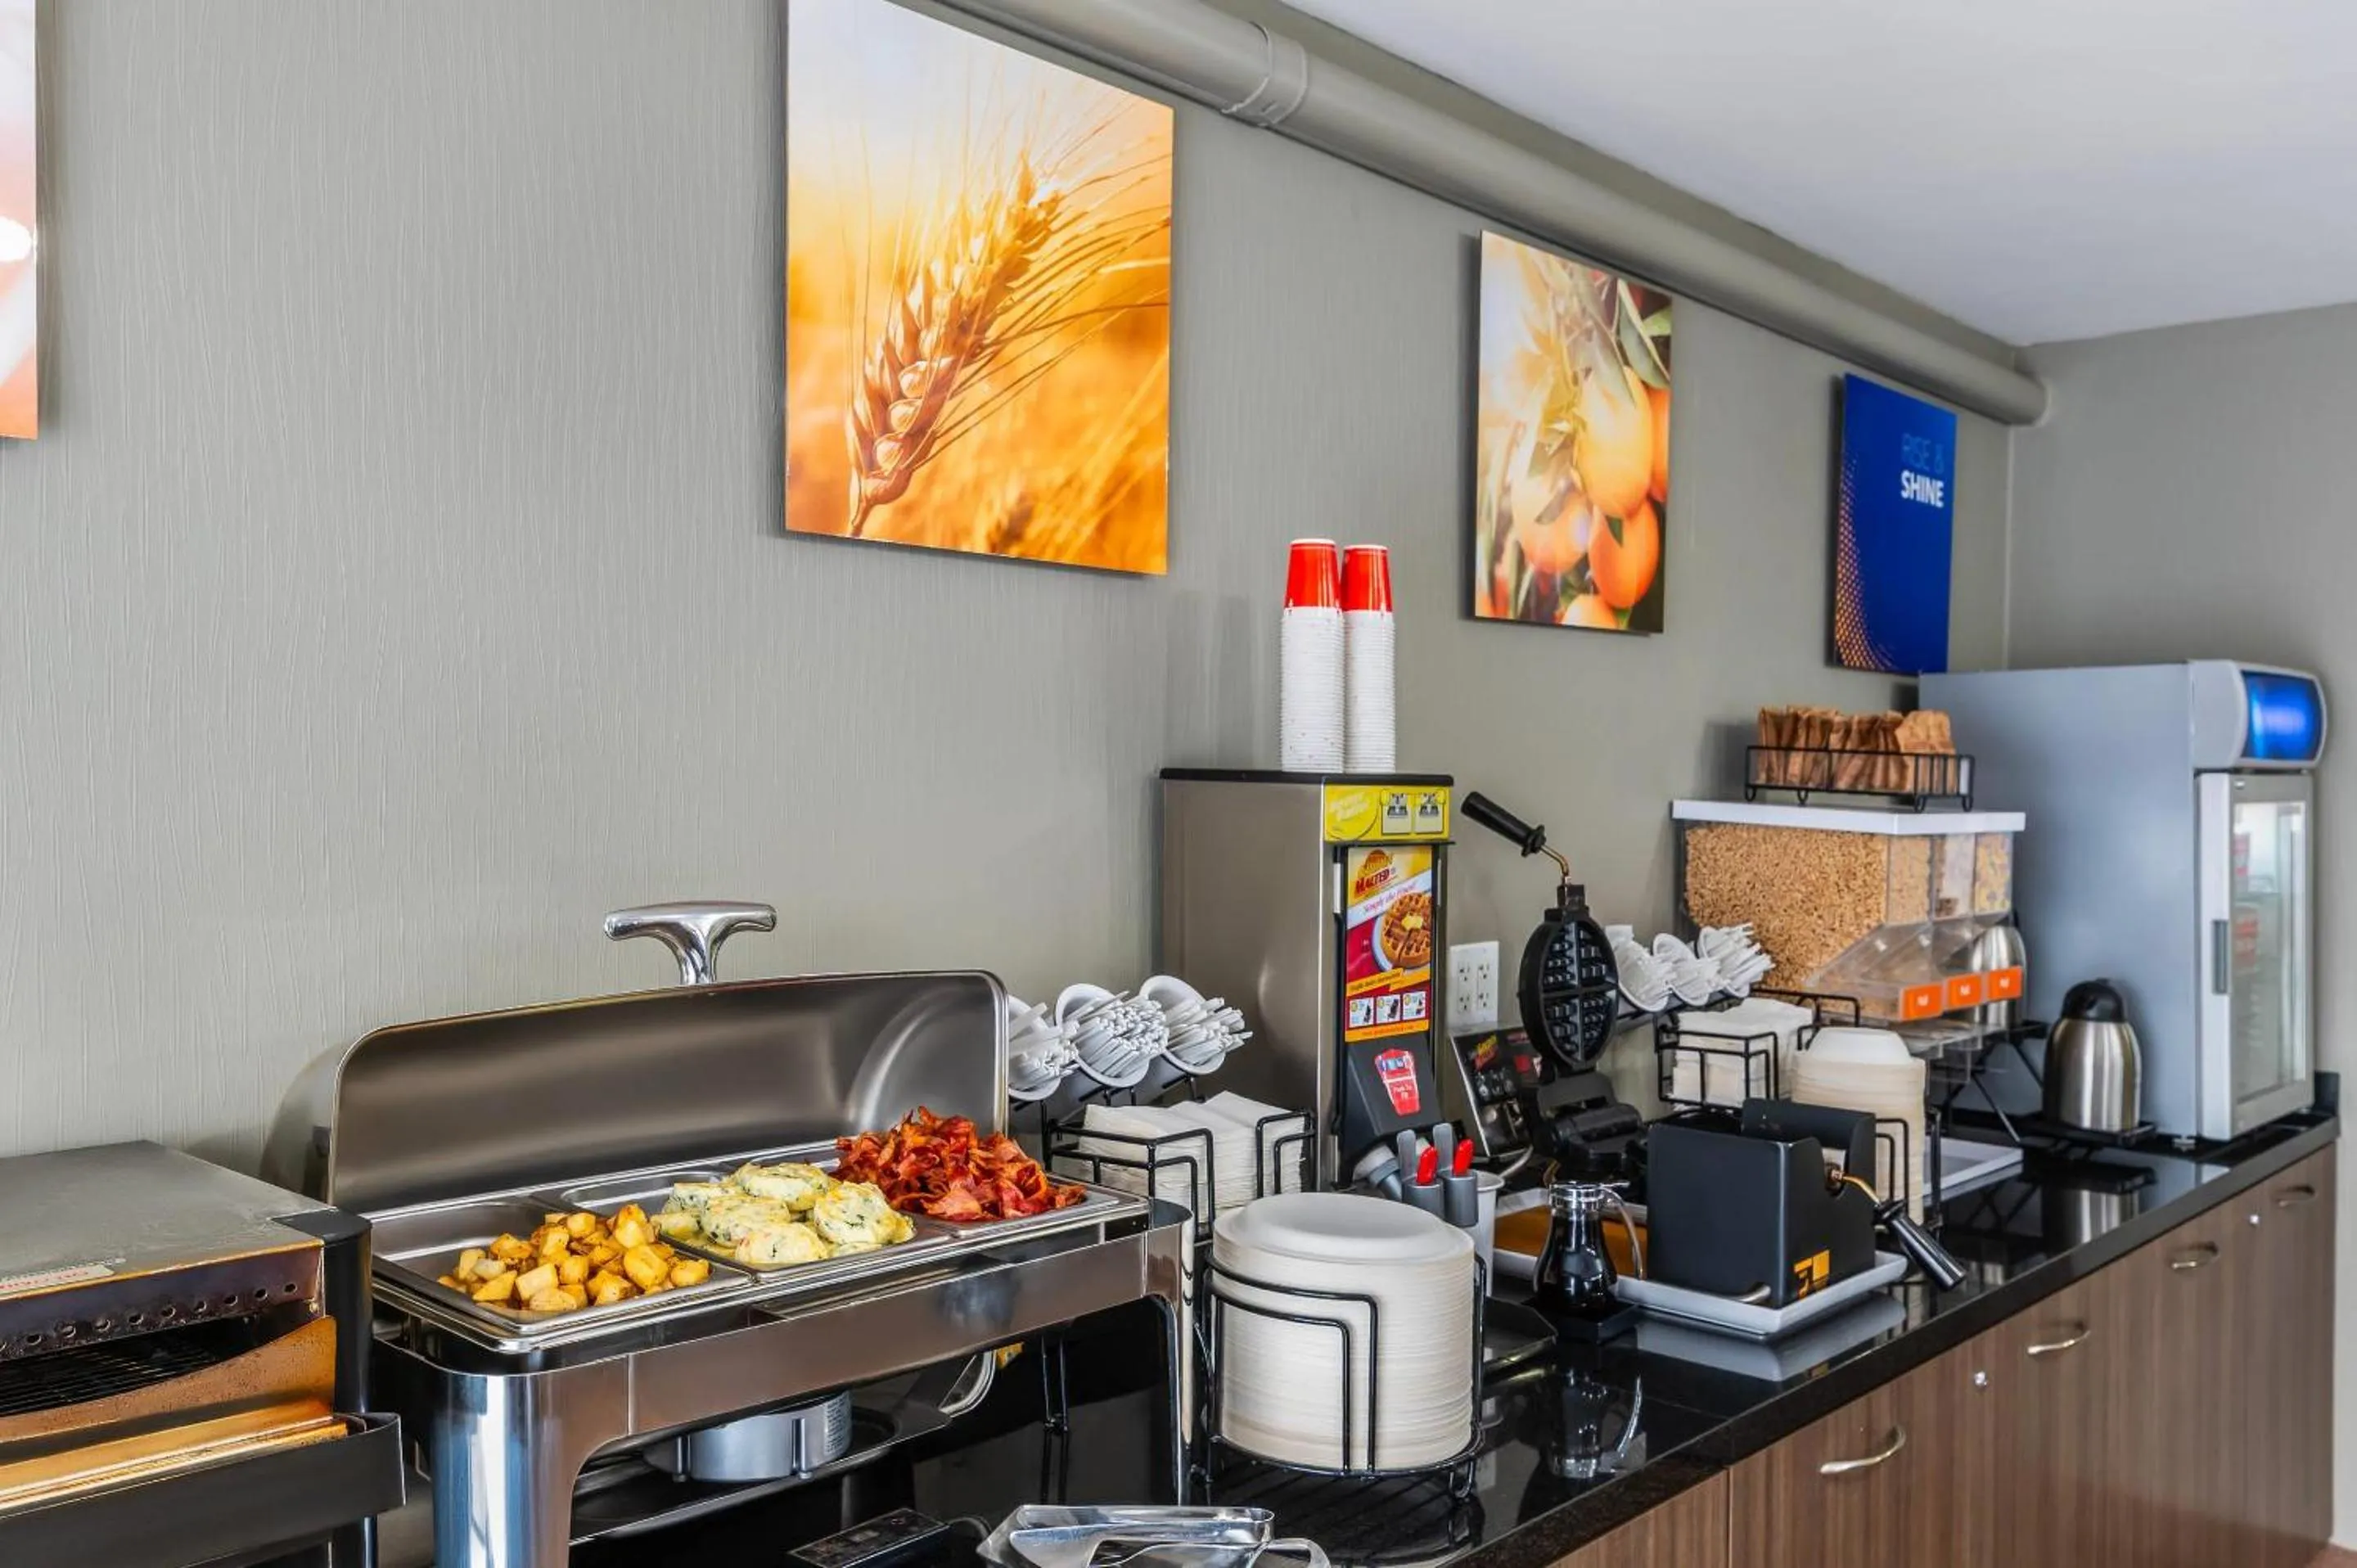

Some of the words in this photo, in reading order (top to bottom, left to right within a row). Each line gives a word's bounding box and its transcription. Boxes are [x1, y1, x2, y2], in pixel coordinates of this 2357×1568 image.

[1901, 433, 1931, 471] RISE
[1900, 469, 1944, 507] SHINE
[1355, 867, 1390, 895] MALTED
